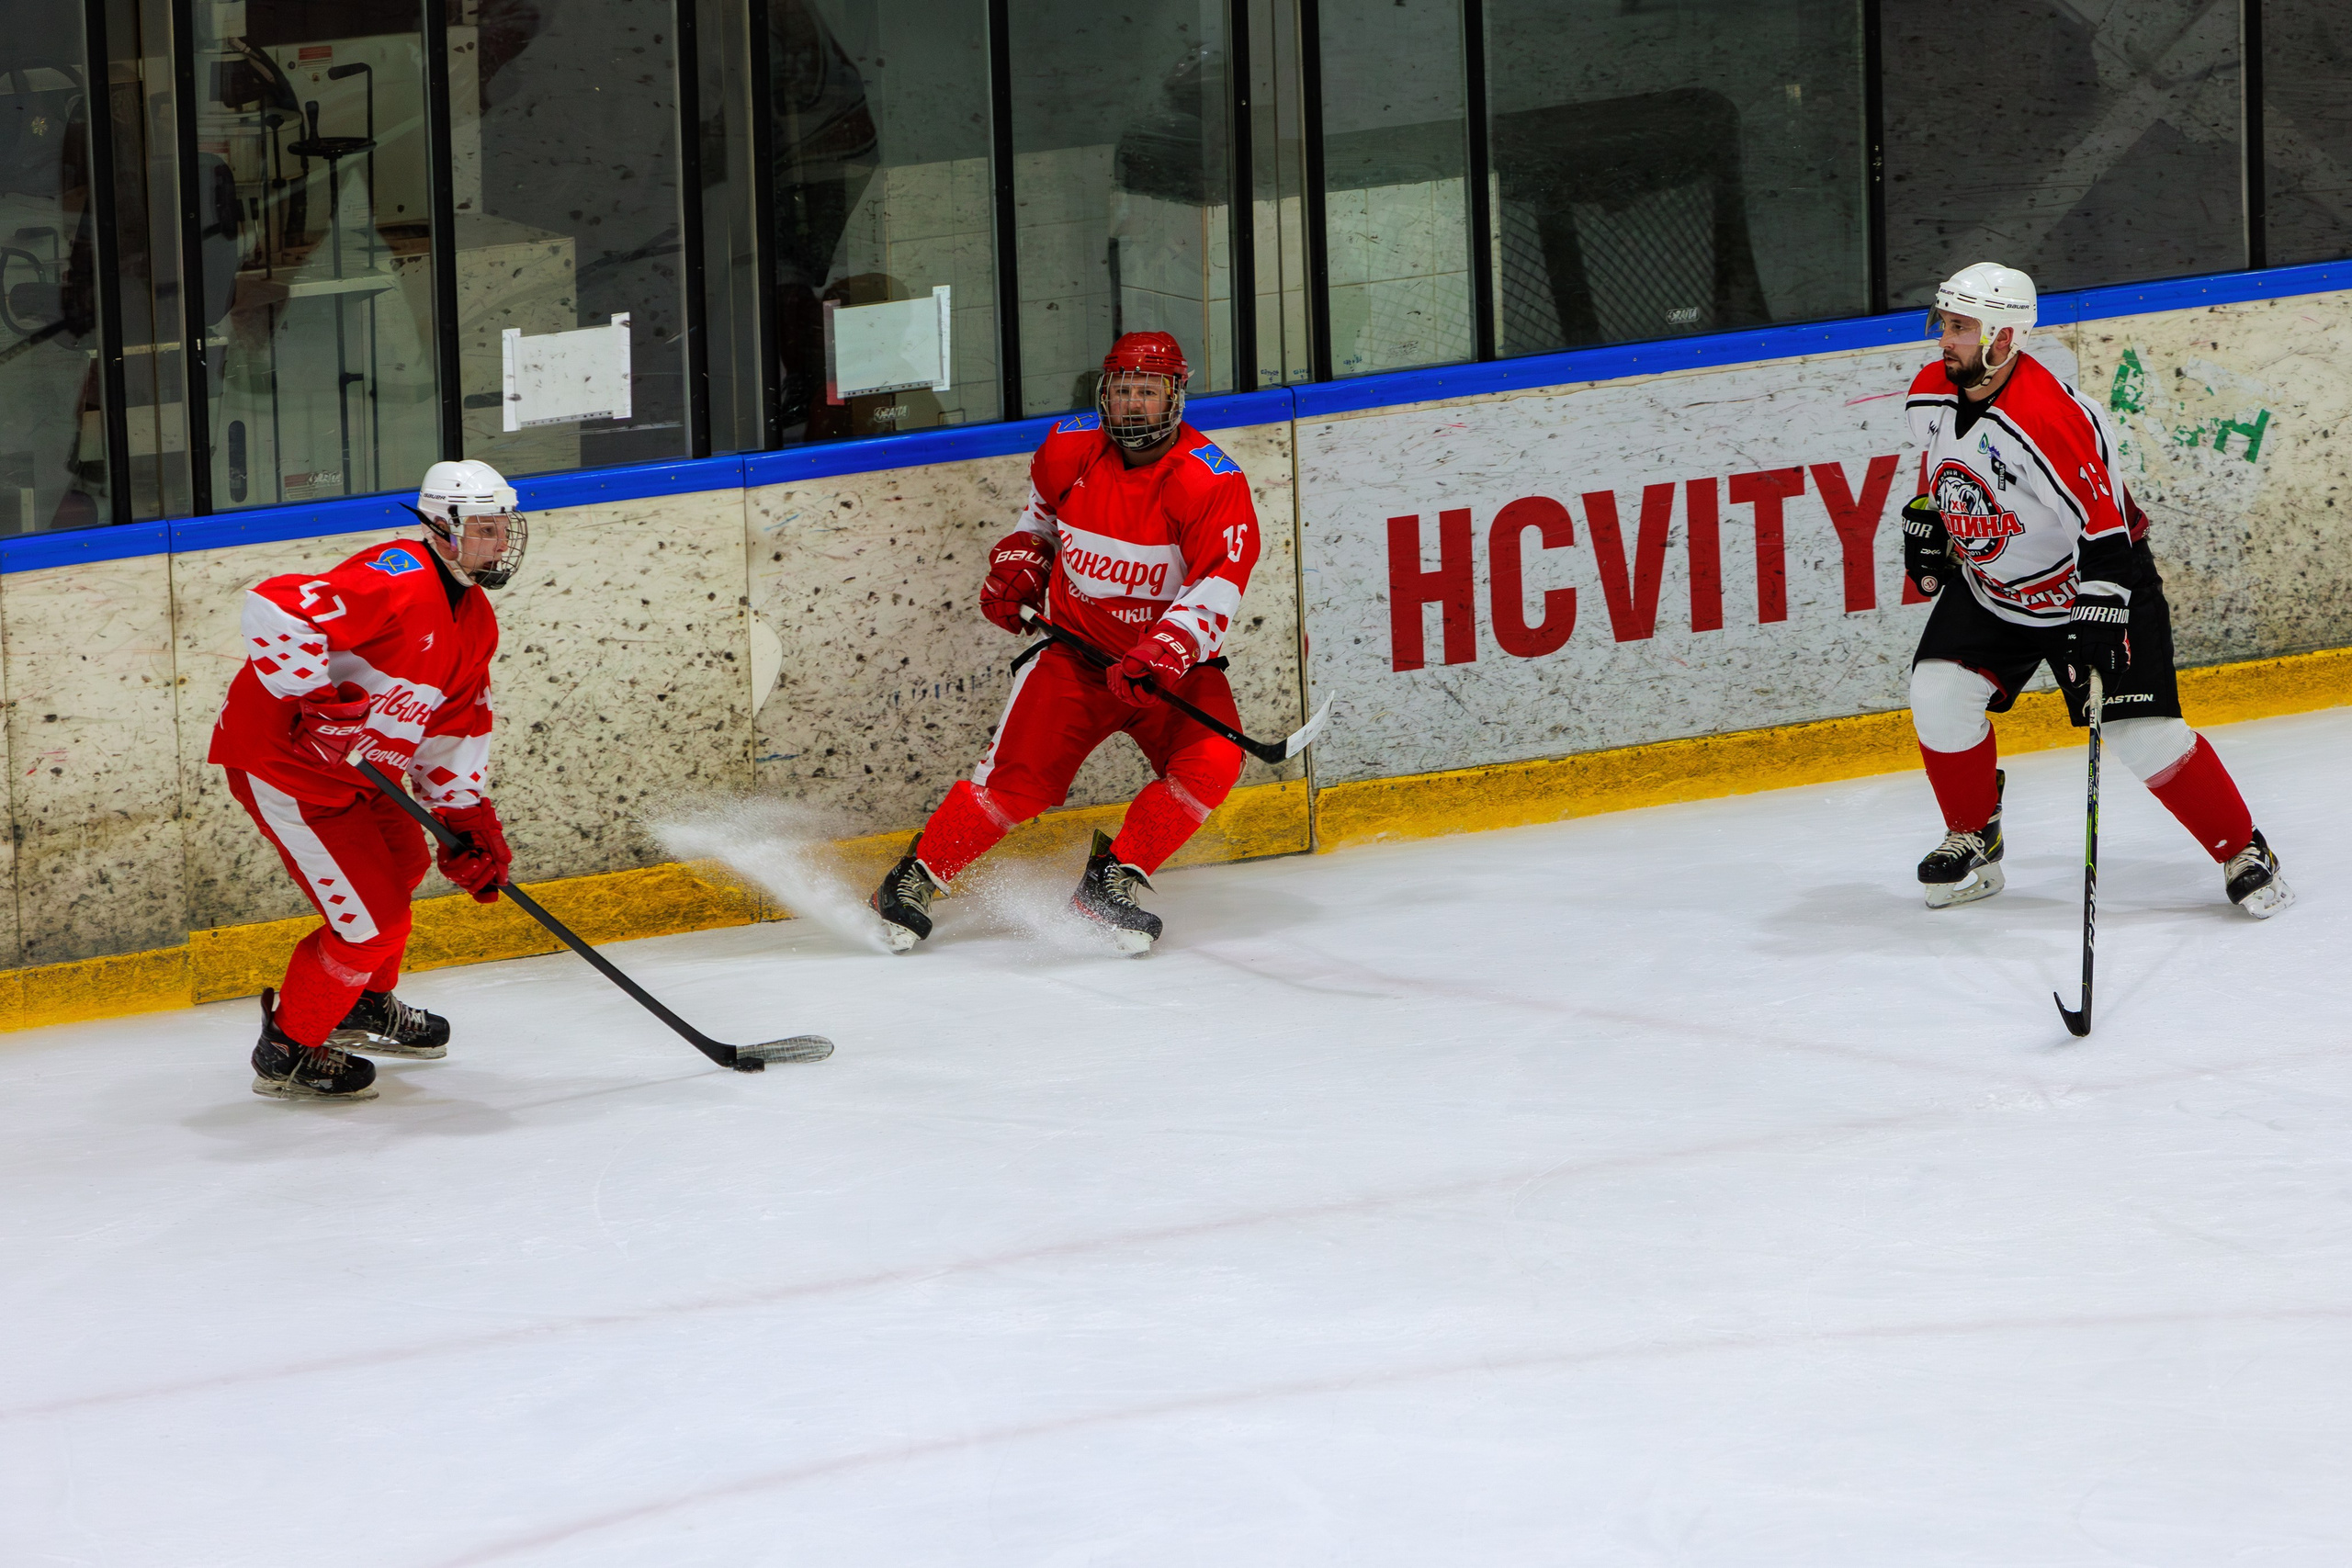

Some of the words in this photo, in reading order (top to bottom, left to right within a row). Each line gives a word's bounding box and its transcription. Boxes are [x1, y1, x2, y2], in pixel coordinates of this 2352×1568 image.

[1222, 523, 1248, 563] 15
[994, 549, 1053, 573] BAUE
[299, 580, 346, 624] 47
[2070, 605, 2130, 624] WARRIO
[369, 684, 431, 726] Аван
[316, 723, 366, 736] BAU
